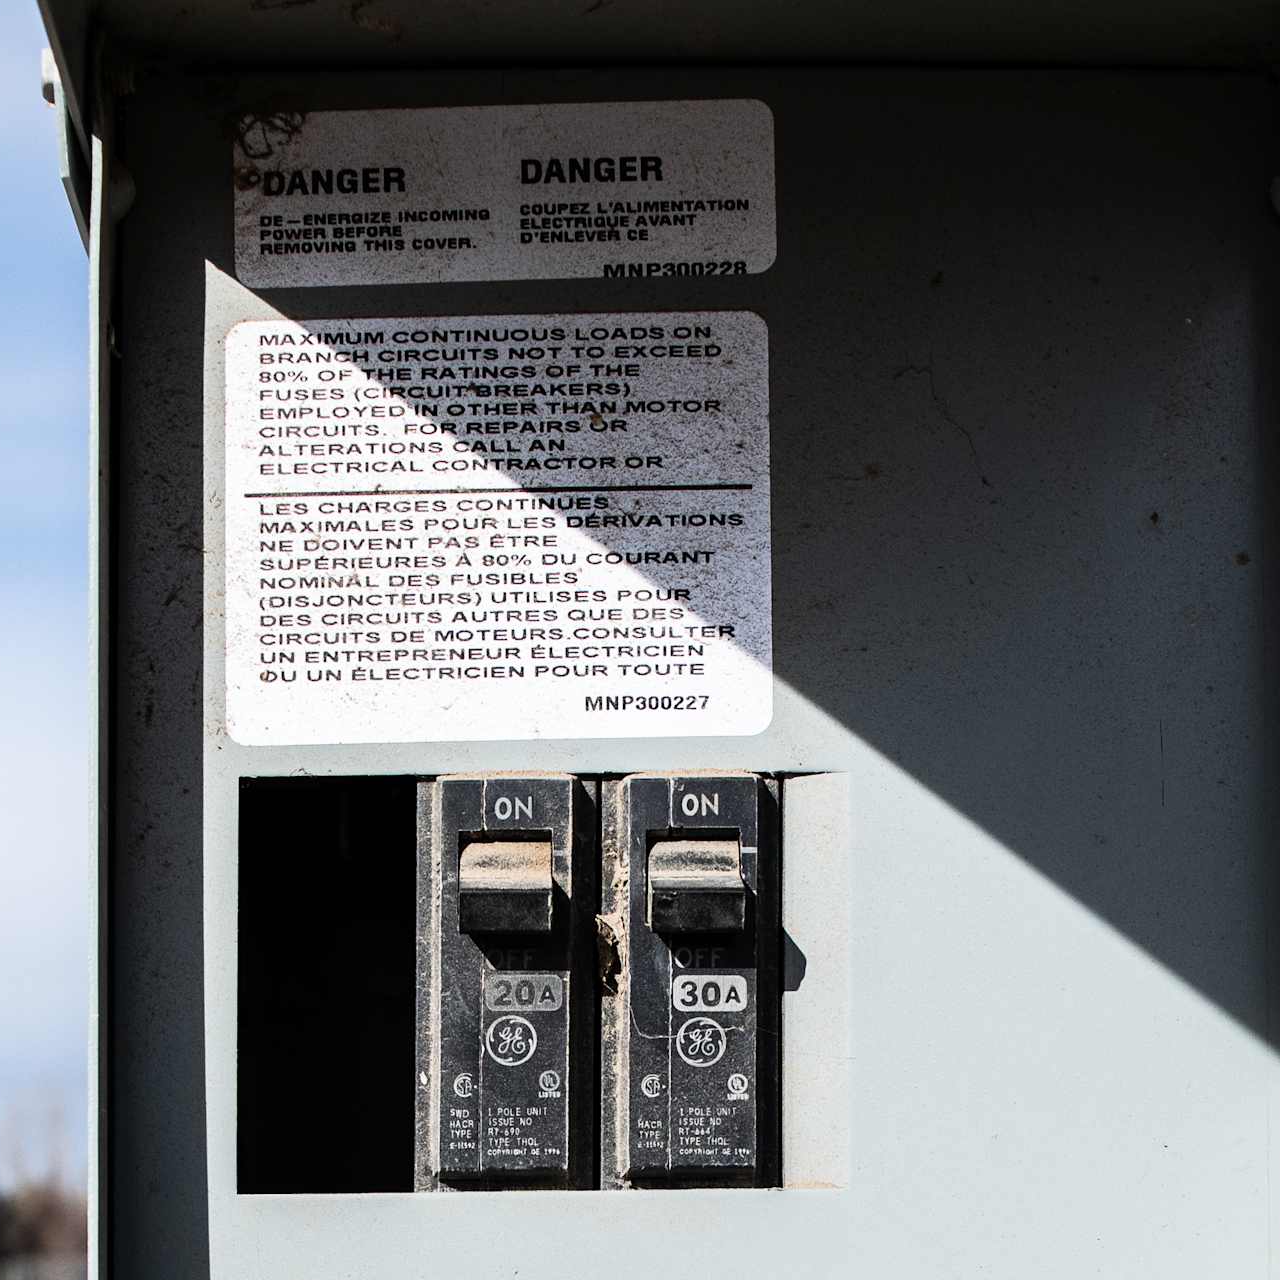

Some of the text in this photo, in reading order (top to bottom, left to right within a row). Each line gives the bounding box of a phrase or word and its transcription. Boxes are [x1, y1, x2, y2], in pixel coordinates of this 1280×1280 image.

[521, 156, 663, 184] DANGER
[264, 168, 405, 196] DANGER
[398, 208, 490, 222] INCOMING
[521, 200, 749, 216] COUPEZ L'ALIMENTATION
[260, 224, 402, 240] POWER BEFORE
[521, 215, 696, 231] ELECTRIQUE AVANT
[521, 229, 649, 244] D'ENLEVER CE
[260, 237, 478, 255] REMOVING THIS COVER.
[604, 261, 747, 277] MNP300228
[259, 326, 710, 346] MAXIMUM CONTINUOUS LOADS ON
[259, 343, 722, 365] BRANCH CIRCUITS NOT TO EXCEED
[259, 364, 639, 383] 80% OF THE RATINGS OF THE
[259, 383, 631, 403] FUSES (CIRCUIT BREAKERS)
[259, 398, 721, 421] EMPLOYED IN OTHER THAN MOTOR
[259, 418, 628, 439] CIRCUITS. FOR REPAIRS OR
[259, 438, 565, 457] ALTERATIONS CALL AN
[259, 455, 663, 475] ELECTRICAL CONTRACTOR OR
[259, 496, 609, 515] LES CHARGES CONTINUES
[259, 512, 744, 533] MAXIMALES POUR LES DÉRIVATIONS
[259, 532, 558, 552] NE DOIVENT PAS ÊTRE
[259, 550, 715, 571] SUPÉRIEURES À 80% DU COURANT
[259, 572, 578, 589] NOMINAL DES FUSIBLES
[258, 588, 691, 610] (DISJONCTEURS) UTILISES POUR
[259, 607, 685, 626] DES CIRCUITS AUTRES QUE DES
[259, 630, 380, 645] CIRCUITS
[391, 629, 426, 643] DE
[259, 643, 704, 664] UN ENTREPRENEUR ÉLECTRICIEN
[307, 667, 342, 681] UN
[352, 664, 524, 680] ÉLECTRICIEN
[534, 663, 609, 678] POUR
[619, 663, 705, 676] TOUTE
[585, 695, 710, 713] MNP300227
[495, 797, 533, 820] ON
[682, 794, 719, 816] ON
[450, 1109, 469, 1118] SWD
[497, 1108, 520, 1116] POLE
[527, 1107, 547, 1116] UNIT
[689, 1108, 711, 1116] POLE
[717, 1107, 736, 1116] UNIT
[450, 1120, 474, 1128] HACR
[489, 1118, 514, 1126] ISSUE
[638, 1120, 662, 1128] HACR
[679, 1117, 722, 1126] ISSUE NO
[451, 1130, 472, 1138] TYPE
[489, 1138, 510, 1146] TYPE
[640, 1131, 660, 1139] TYPE
[680, 1137, 701, 1145] TYPE
